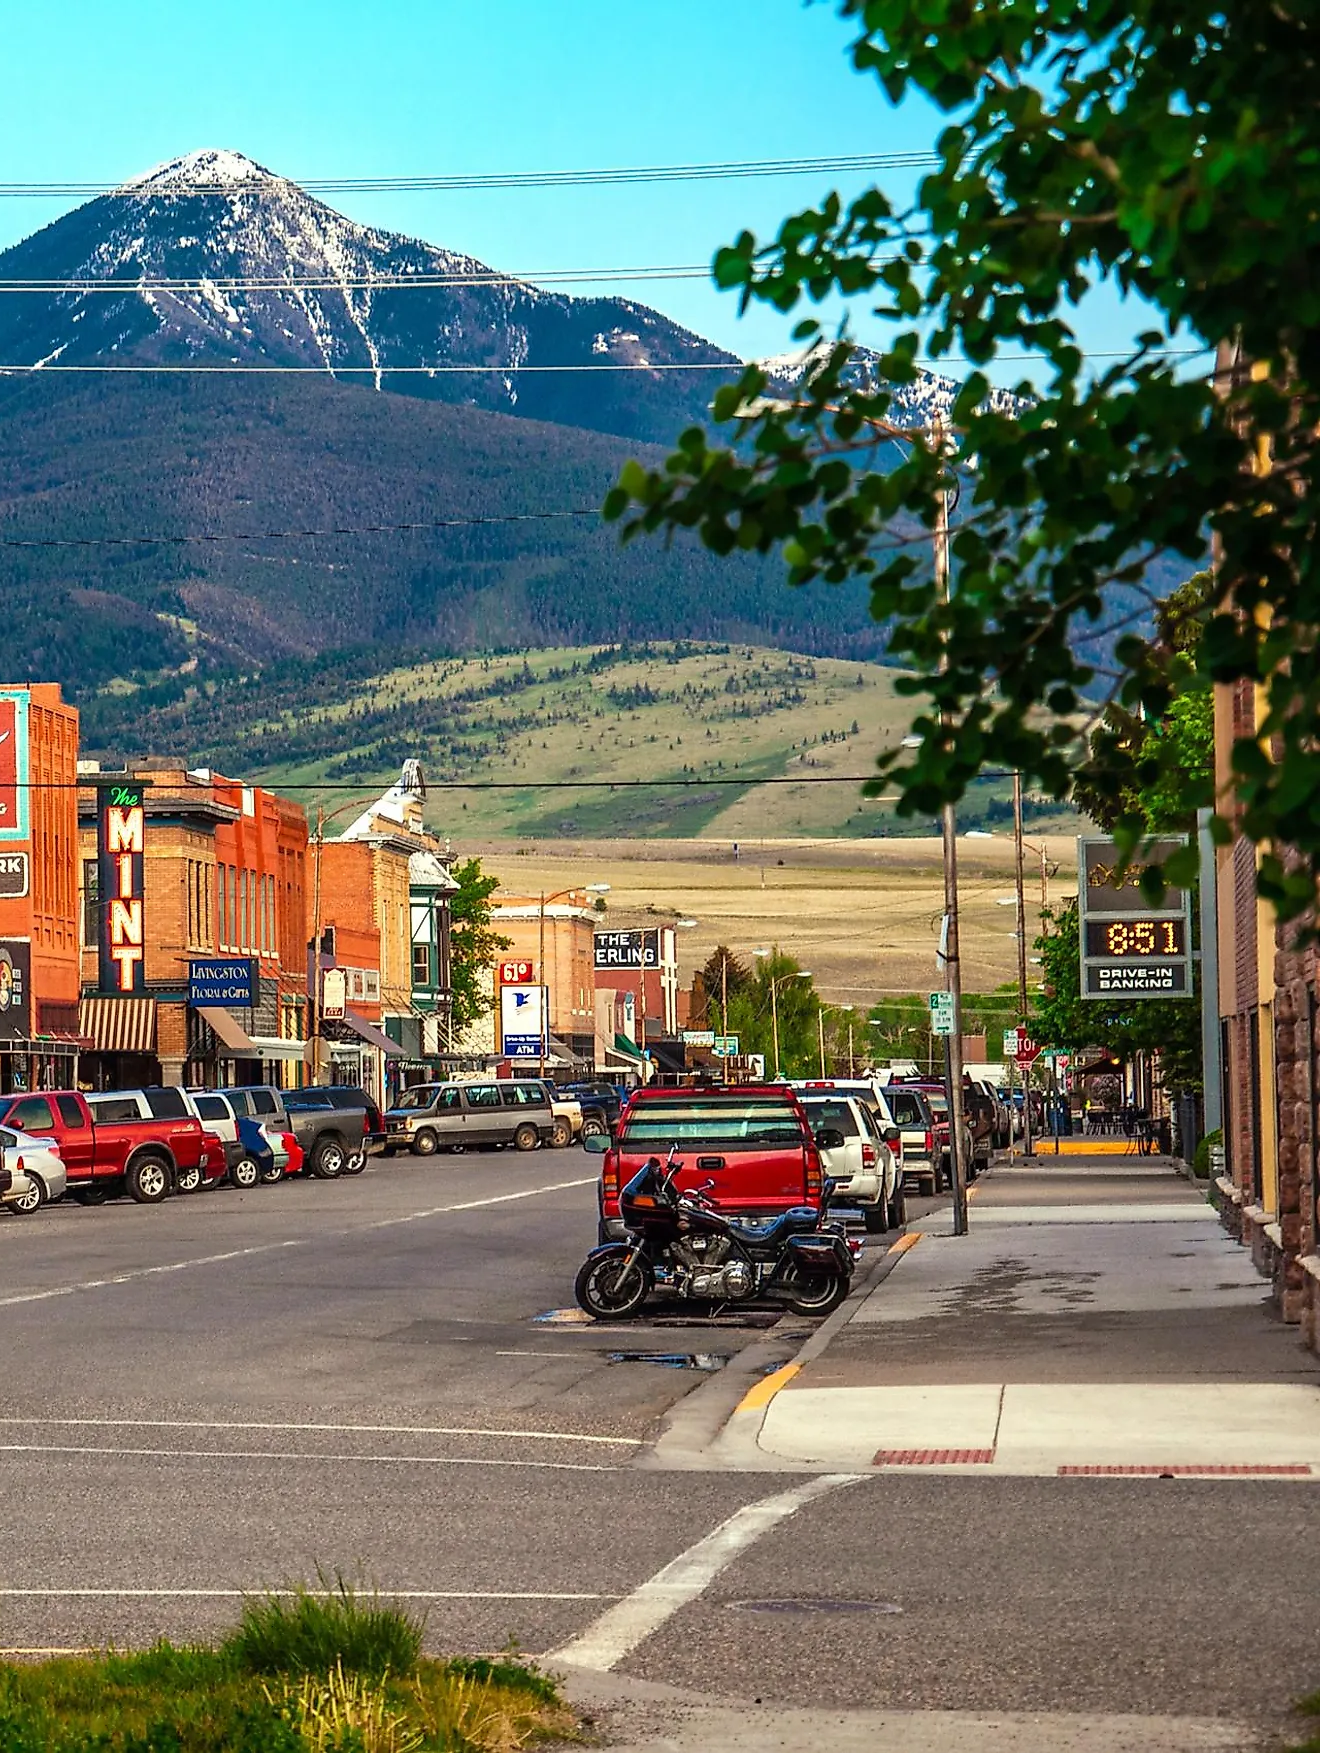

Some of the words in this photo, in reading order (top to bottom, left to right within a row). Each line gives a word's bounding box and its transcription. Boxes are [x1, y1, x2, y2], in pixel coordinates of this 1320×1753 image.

[111, 786, 139, 806] The
[108, 806, 144, 992] MINT
[597, 933, 630, 946] THE
[1107, 922, 1179, 955] 8:51
[593, 948, 655, 963] ERLING
[1099, 968, 1173, 979] DRIVE-IN
[1099, 978, 1173, 989] BANKING
[516, 1045, 534, 1054] ATM
